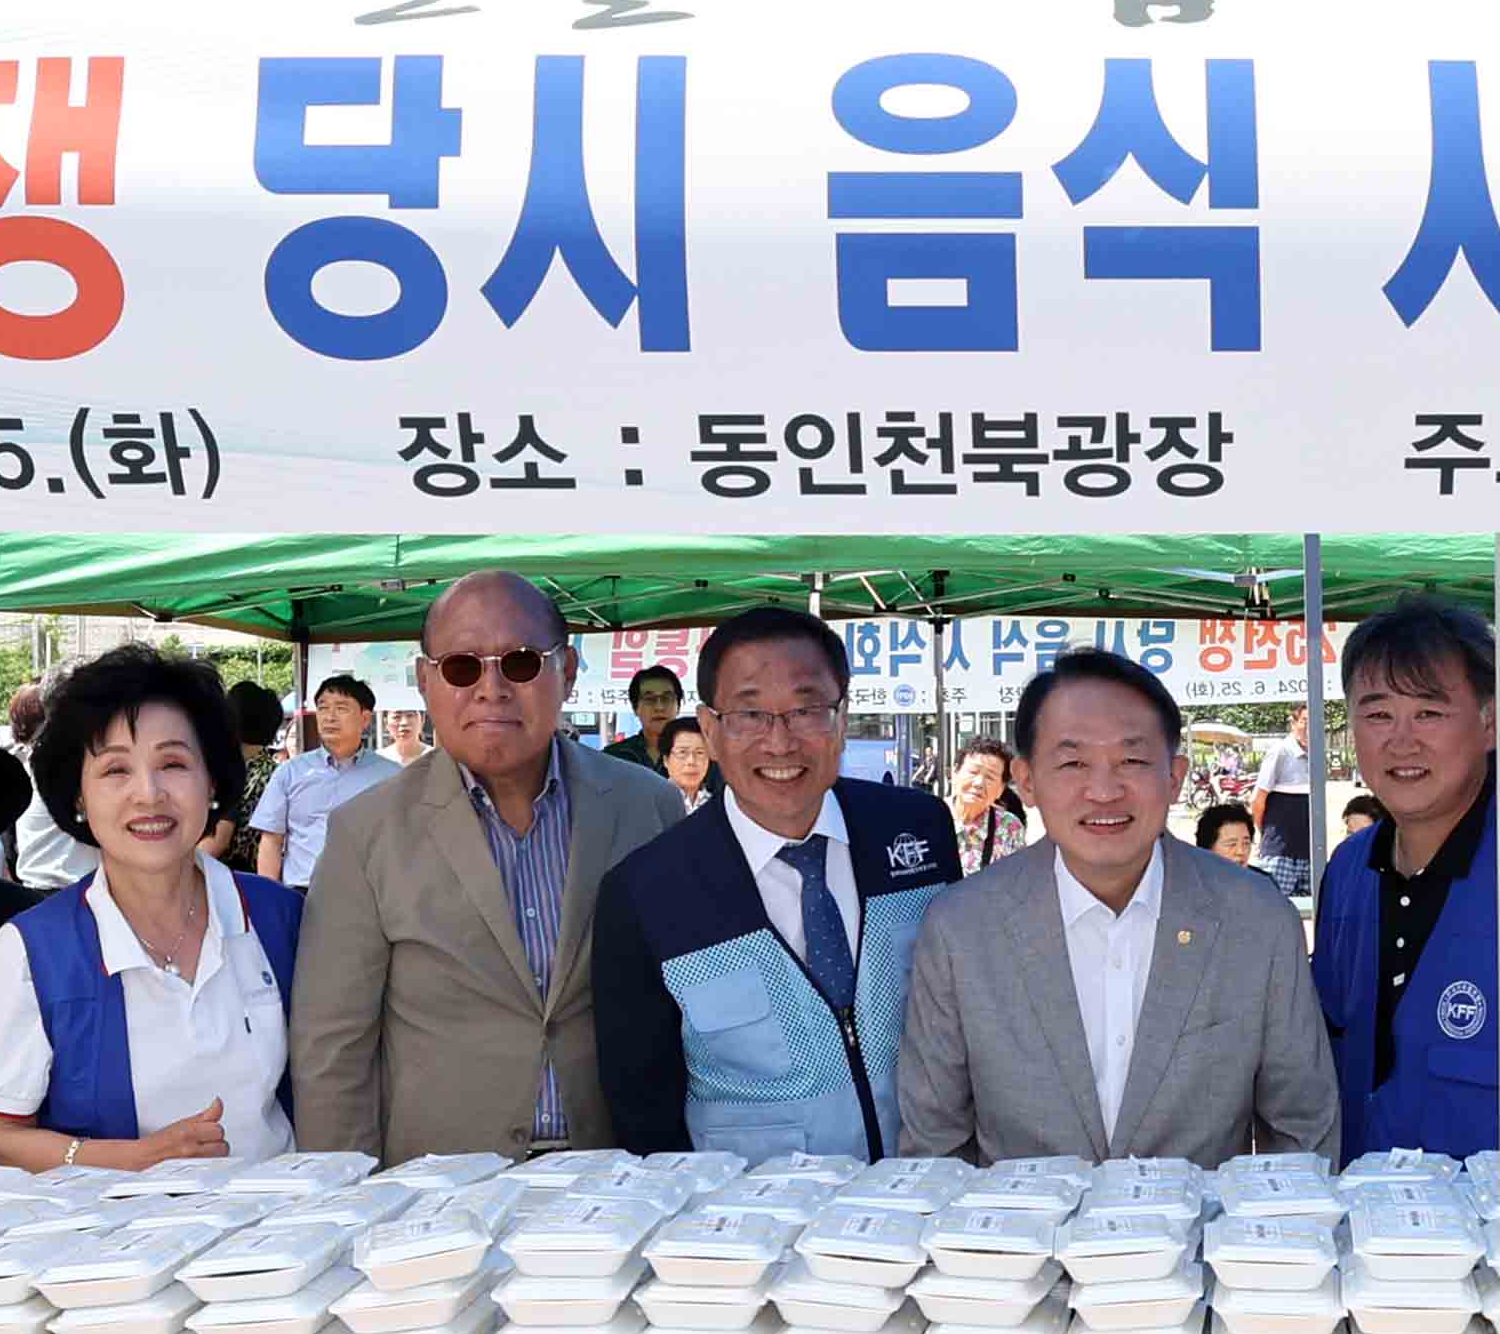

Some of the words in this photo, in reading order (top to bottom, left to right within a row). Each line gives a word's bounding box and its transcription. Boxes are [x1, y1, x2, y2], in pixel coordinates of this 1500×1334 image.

[254, 55, 691, 360] 당시
[827, 53, 1261, 352] 음식
[398, 411, 577, 497] 장소
[690, 410, 1234, 499] 동인천북광장
[886, 839, 930, 868] KFF
[1446, 1002, 1477, 1020] KFF
